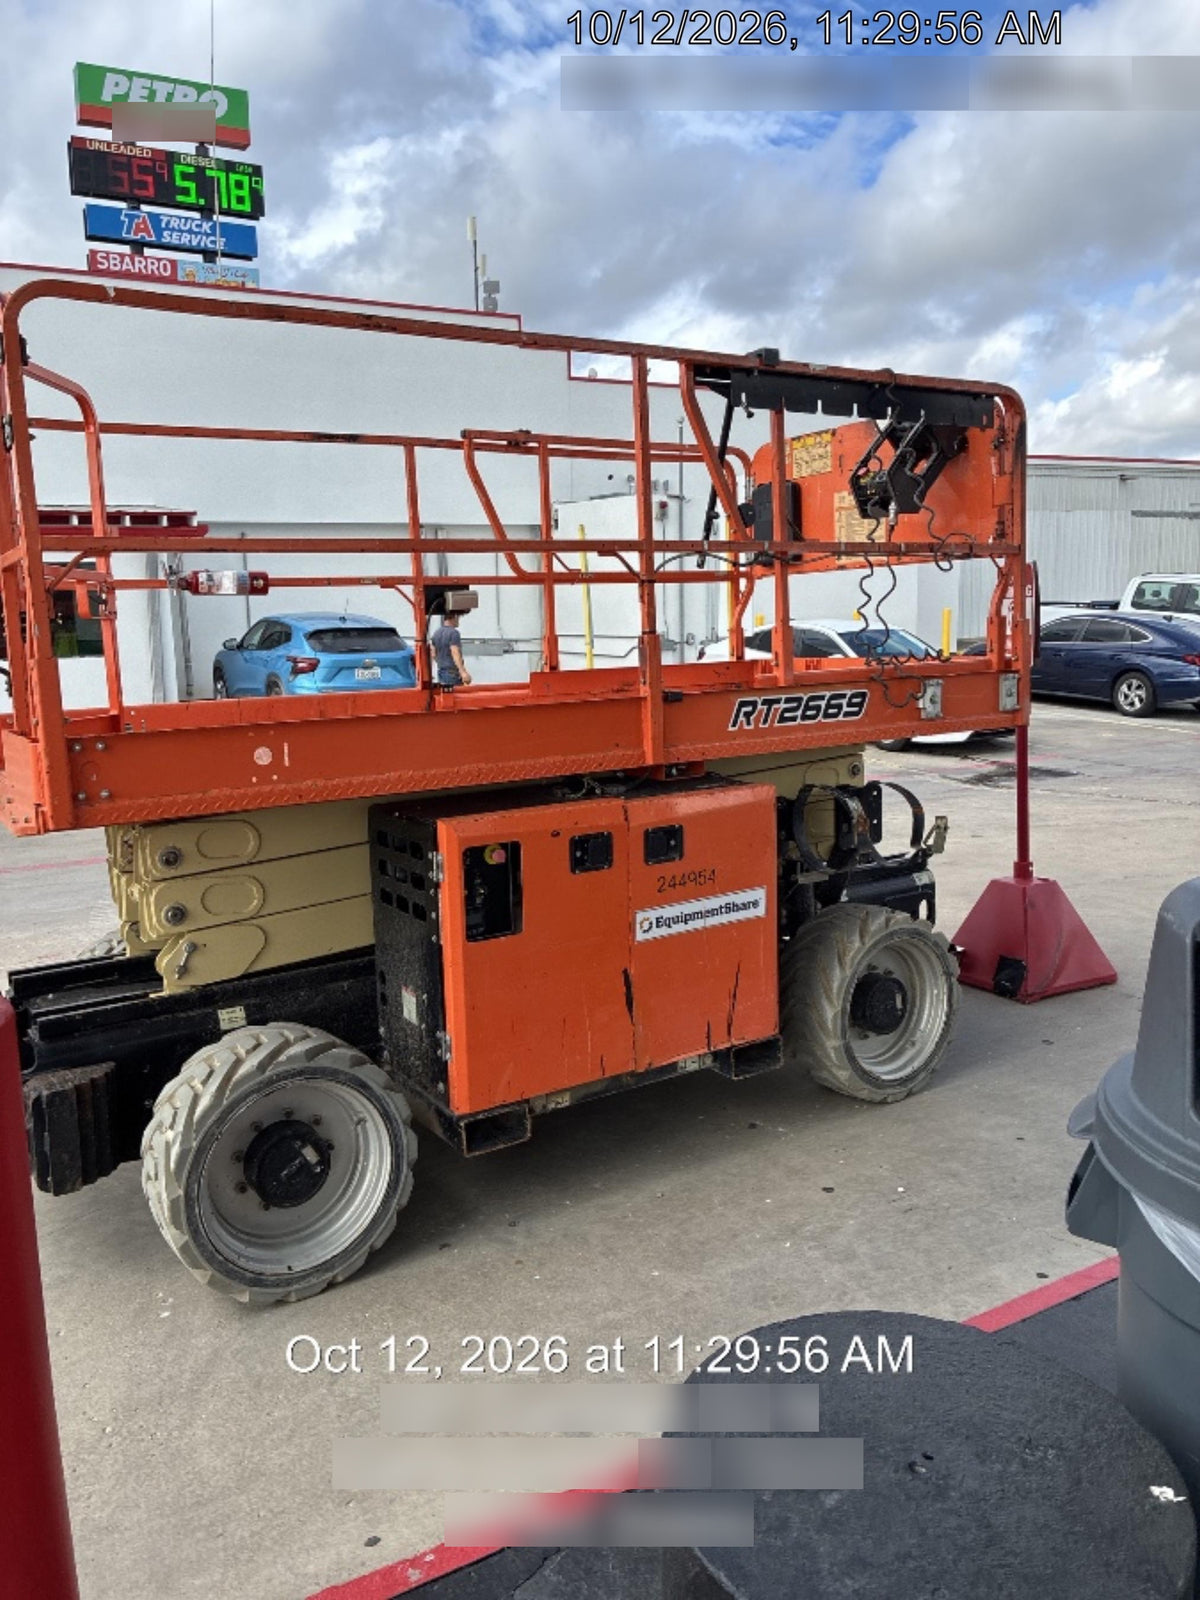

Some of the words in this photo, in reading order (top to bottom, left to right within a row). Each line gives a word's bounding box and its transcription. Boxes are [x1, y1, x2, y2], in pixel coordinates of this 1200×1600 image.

[86, 139, 152, 158] UNLEADED
[180, 153, 216, 169] DIESEL
[120, 209, 156, 240] TA
[160, 214, 213, 234] TRUCK
[161, 230, 226, 249] SERVICE
[96, 252, 172, 277] SBARRO
[728, 690, 869, 732] RT2669
[656, 868, 717, 894] 244954
[655, 899, 761, 930] EquipmentShare
